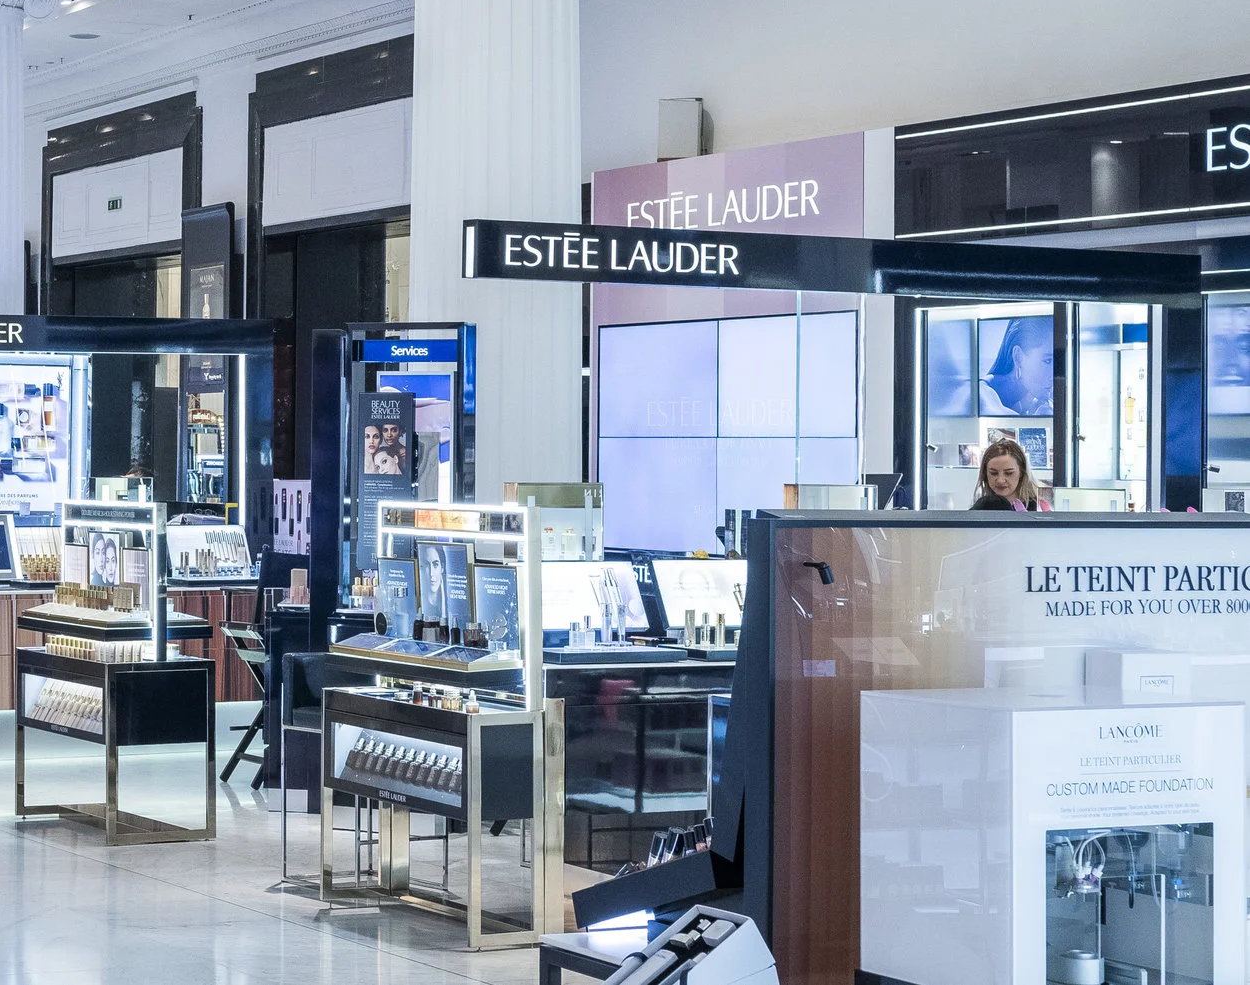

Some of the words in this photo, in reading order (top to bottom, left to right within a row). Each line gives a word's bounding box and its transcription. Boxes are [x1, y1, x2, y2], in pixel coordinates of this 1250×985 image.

[1206, 123, 1250, 172] ES
[707, 179, 820, 227] LAUDER
[611, 238, 739, 275] LAUDER
[391, 345, 428, 356] Services
[371, 400, 400, 408] BEAUTY
[371, 407, 400, 415] SERVICES
[1025, 566, 1061, 592] LE
[1067, 566, 1156, 592] TEINT
[1045, 601, 1096, 617] MADE
[1101, 599, 1134, 615] FOR
[1138, 599, 1173, 615] YOU
[1178, 598, 1222, 614] OVER
[1226, 598, 1250, 614] 800
[1099, 722, 1163, 739] LANCÔME
[1080, 757, 1091, 767] LE
[1092, 756, 1121, 766] TEINT
[1123, 754, 1182, 766] PARTICULIER
[1046, 782, 1099, 797] CUSTOM
[1102, 780, 1135, 794] MADE
[1139, 777, 1213, 793] FOUNDATION
